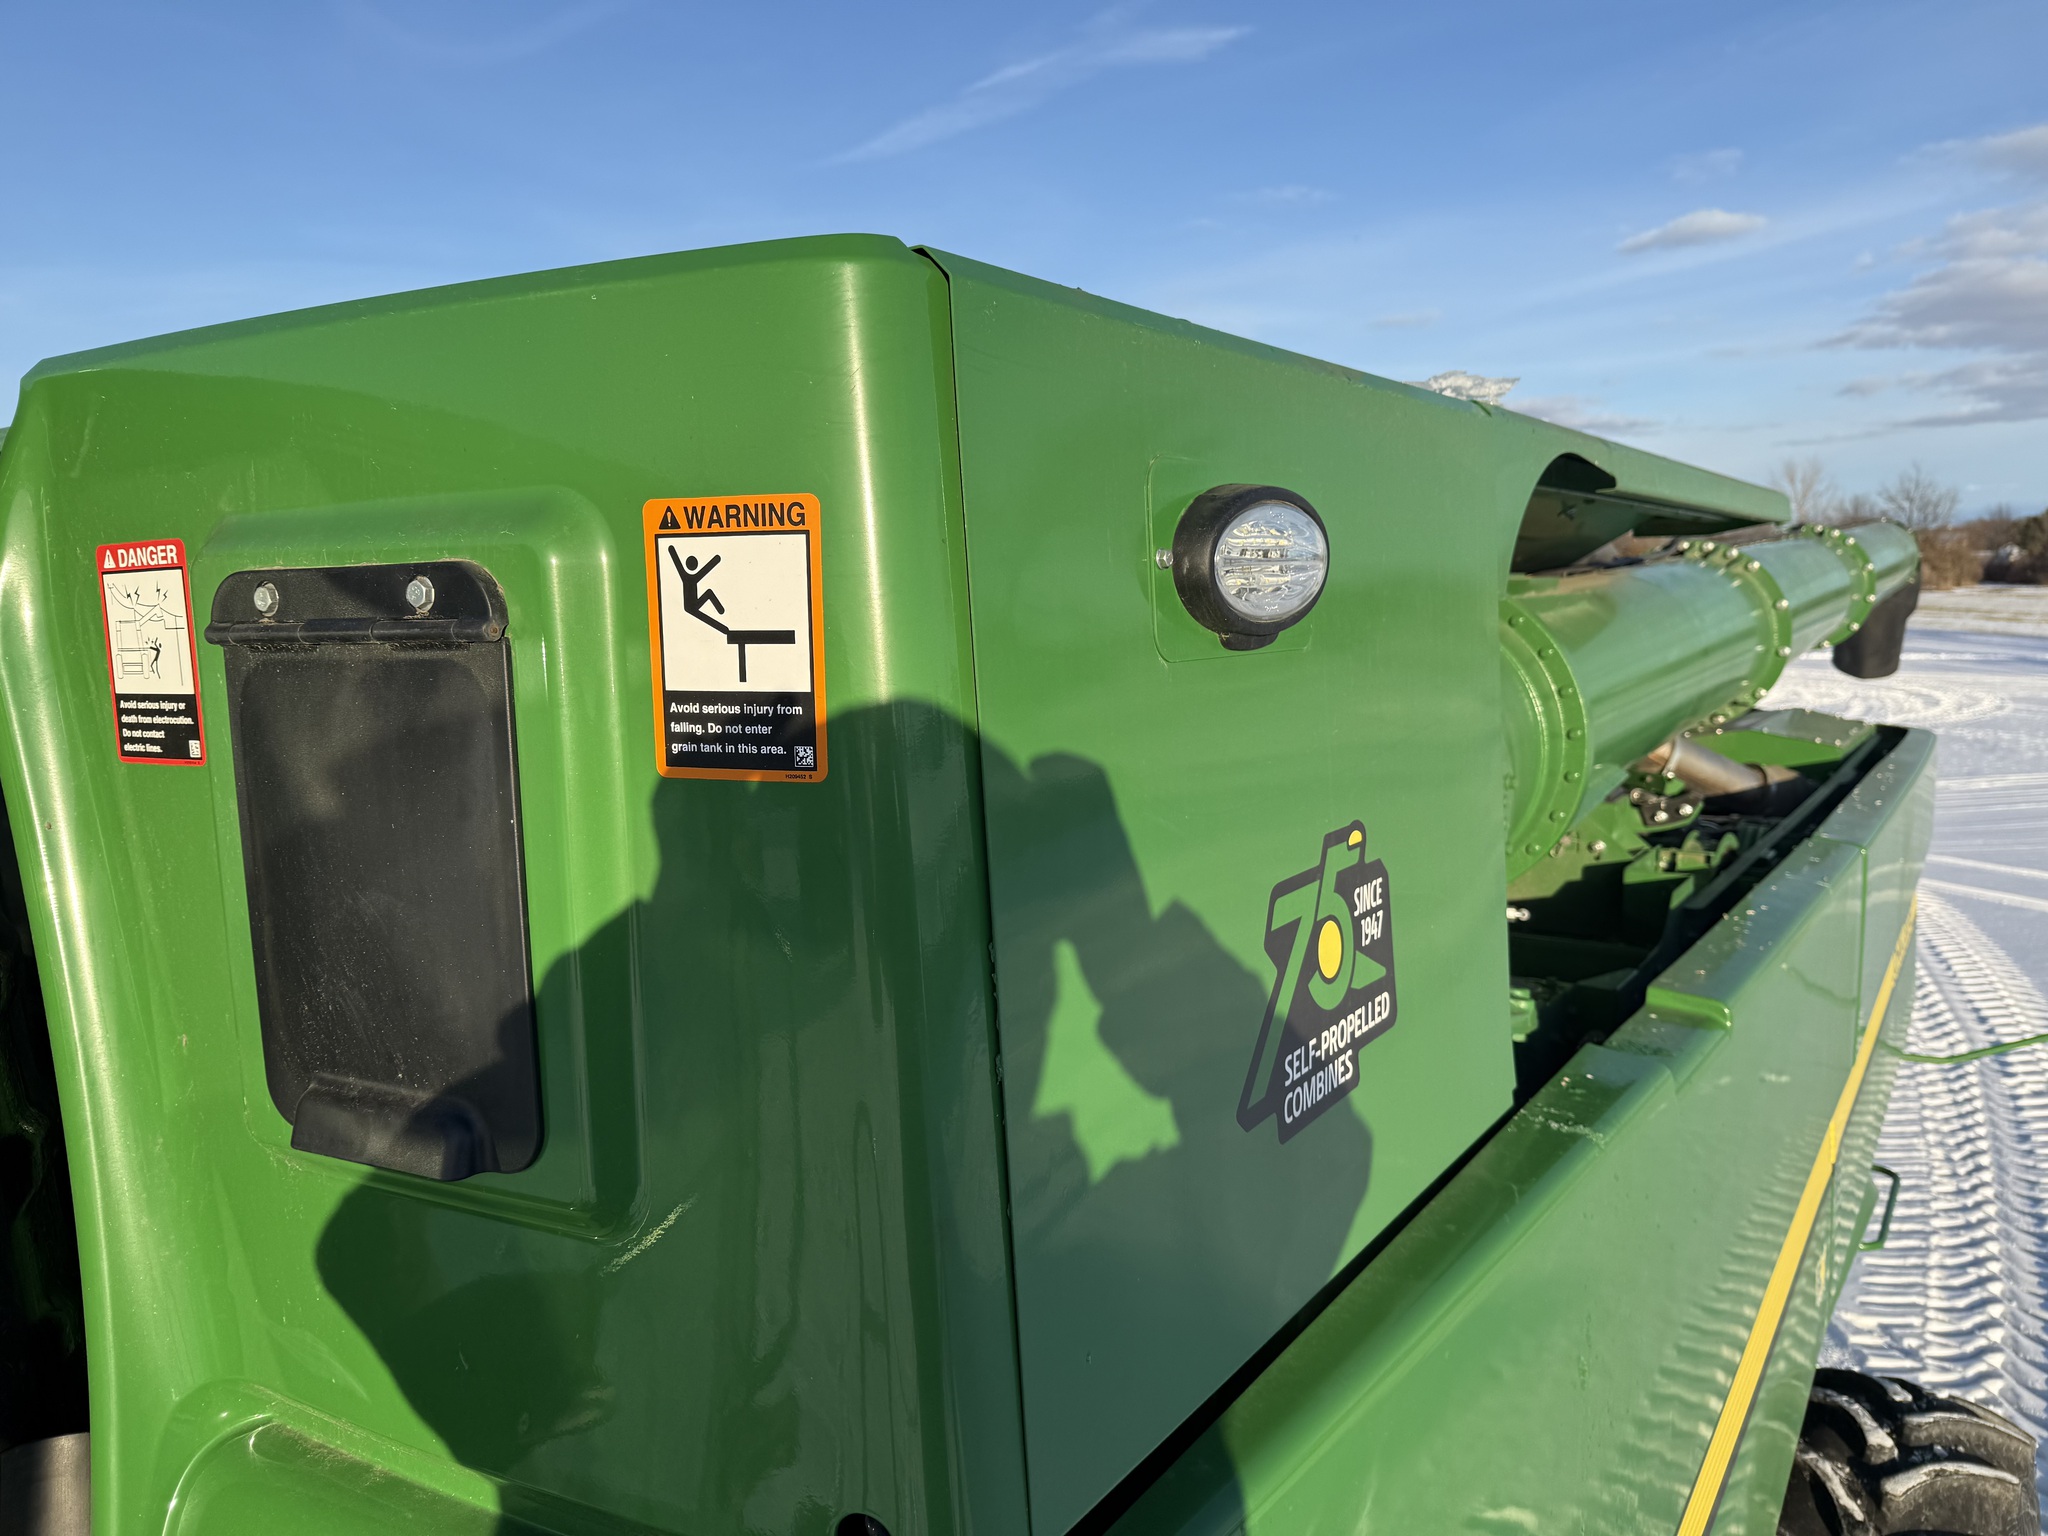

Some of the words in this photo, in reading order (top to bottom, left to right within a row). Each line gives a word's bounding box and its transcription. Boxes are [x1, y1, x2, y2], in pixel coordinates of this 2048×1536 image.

[683, 501, 806, 529] WARNING
[117, 544, 178, 568] DANGER
[120, 700, 137, 709] Avoid
[137, 701, 160, 710] serious
[160, 701, 178, 712] injury
[178, 702, 186, 710] or
[670, 702, 700, 714] Avoid
[701, 703, 741, 715] serious
[743, 703, 774, 717] injury
[776, 704, 803, 716] from
[121, 714, 138, 723] death
[138, 715, 153, 724] from
[153, 715, 195, 725] electrocution.
[122, 728, 132, 738] Do
[131, 730, 142, 738] not
[142, 730, 165, 739] contact
[670, 722, 706, 736] falling.
[707, 722, 723, 734] Do
[725, 723, 743, 735] not
[745, 724, 773, 735] enter
[124, 743, 146, 752] electric
[146, 744, 163, 753] lines.
[671, 741, 698, 755] grain
[700, 742, 723, 754] tank
[725, 742, 735, 754] in
[737, 743, 758, 755] this
[760, 745, 787, 755] area.
[1353, 876, 1383, 917] SINCE
[1360, 909, 1384, 947] 1947
[1284, 991, 1391, 1088] SELF-PROPELLED
[1283, 1048, 1354, 1124] COMBINES
